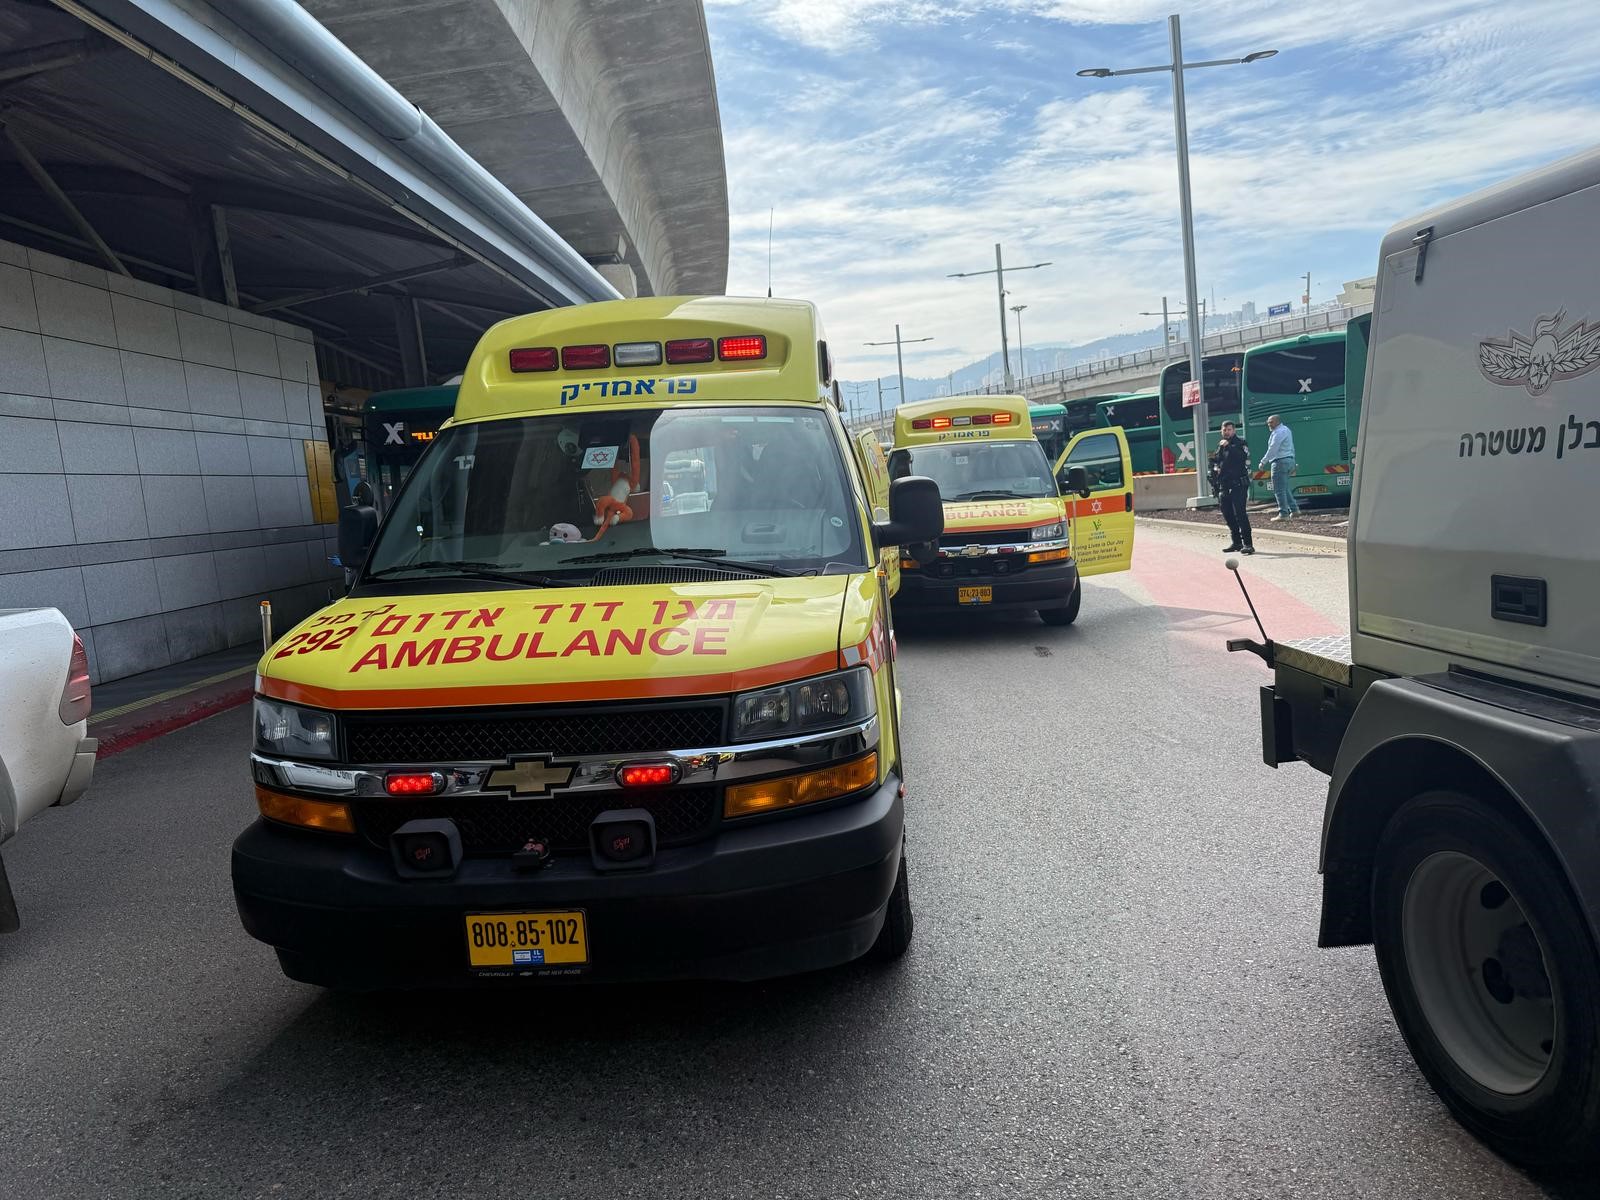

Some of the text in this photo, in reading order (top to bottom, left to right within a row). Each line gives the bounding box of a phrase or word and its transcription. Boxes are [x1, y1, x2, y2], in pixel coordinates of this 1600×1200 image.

[560, 377, 698, 406] פראמדיק
[938, 429, 990, 441] פראמדיק
[1459, 414, 1600, 459] בלן משטרה
[945, 508, 1029, 520] BULANCE
[371, 600, 737, 637] מגן דוד אדום
[274, 626, 359, 660] 292
[348, 627, 730, 673] AMBULANCE
